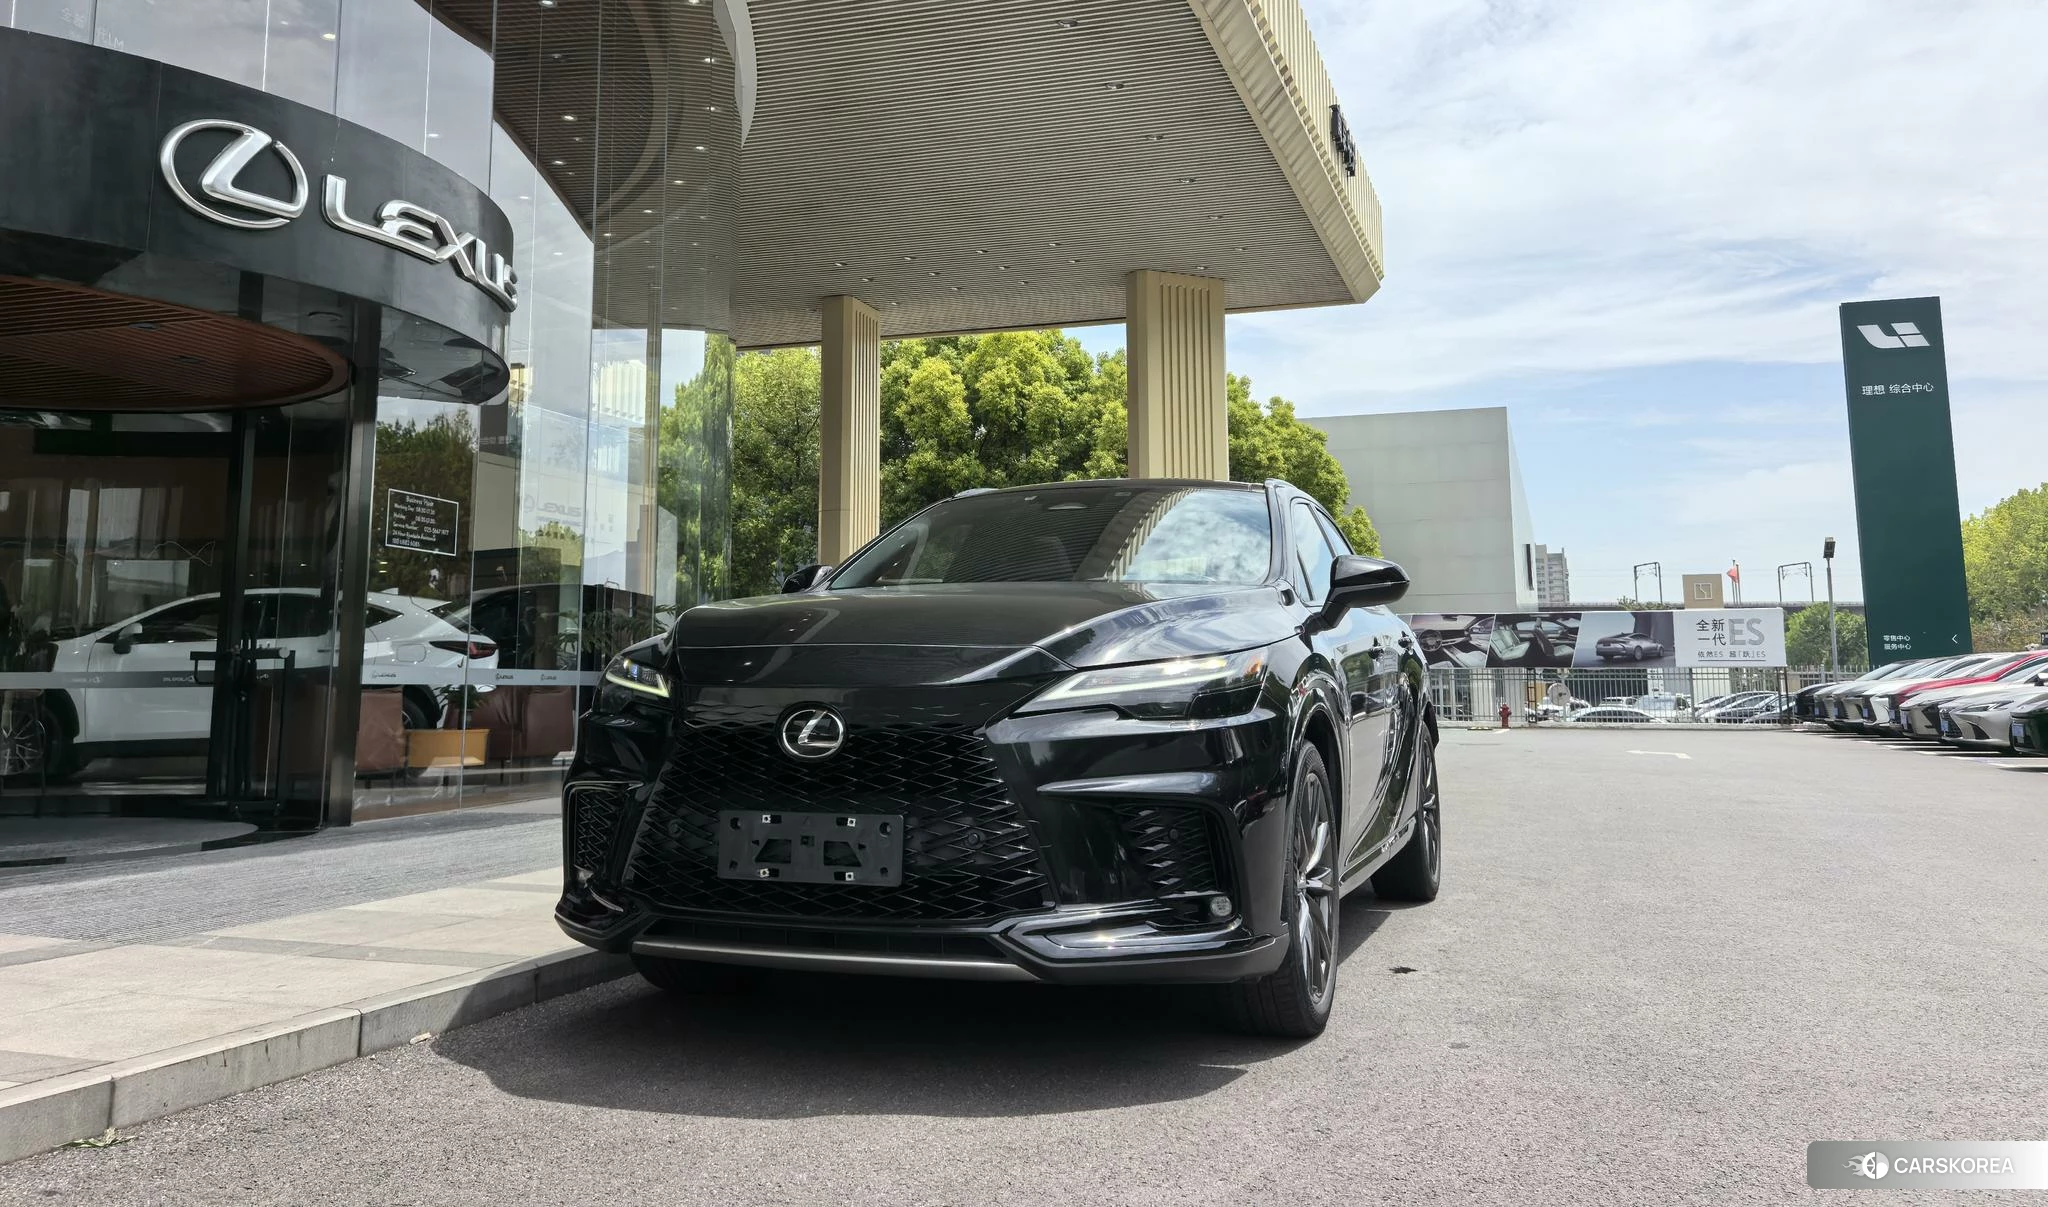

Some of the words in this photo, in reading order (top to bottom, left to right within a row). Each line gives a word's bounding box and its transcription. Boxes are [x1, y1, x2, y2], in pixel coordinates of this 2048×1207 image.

[321, 173, 518, 314] LEXUS
[1861, 384, 1885, 396] 理想
[1888, 382, 1935, 395] 综合中心
[1696, 618, 1725, 632] 全新
[1728, 617, 1765, 646] ES
[1697, 632, 1727, 646] 一代
